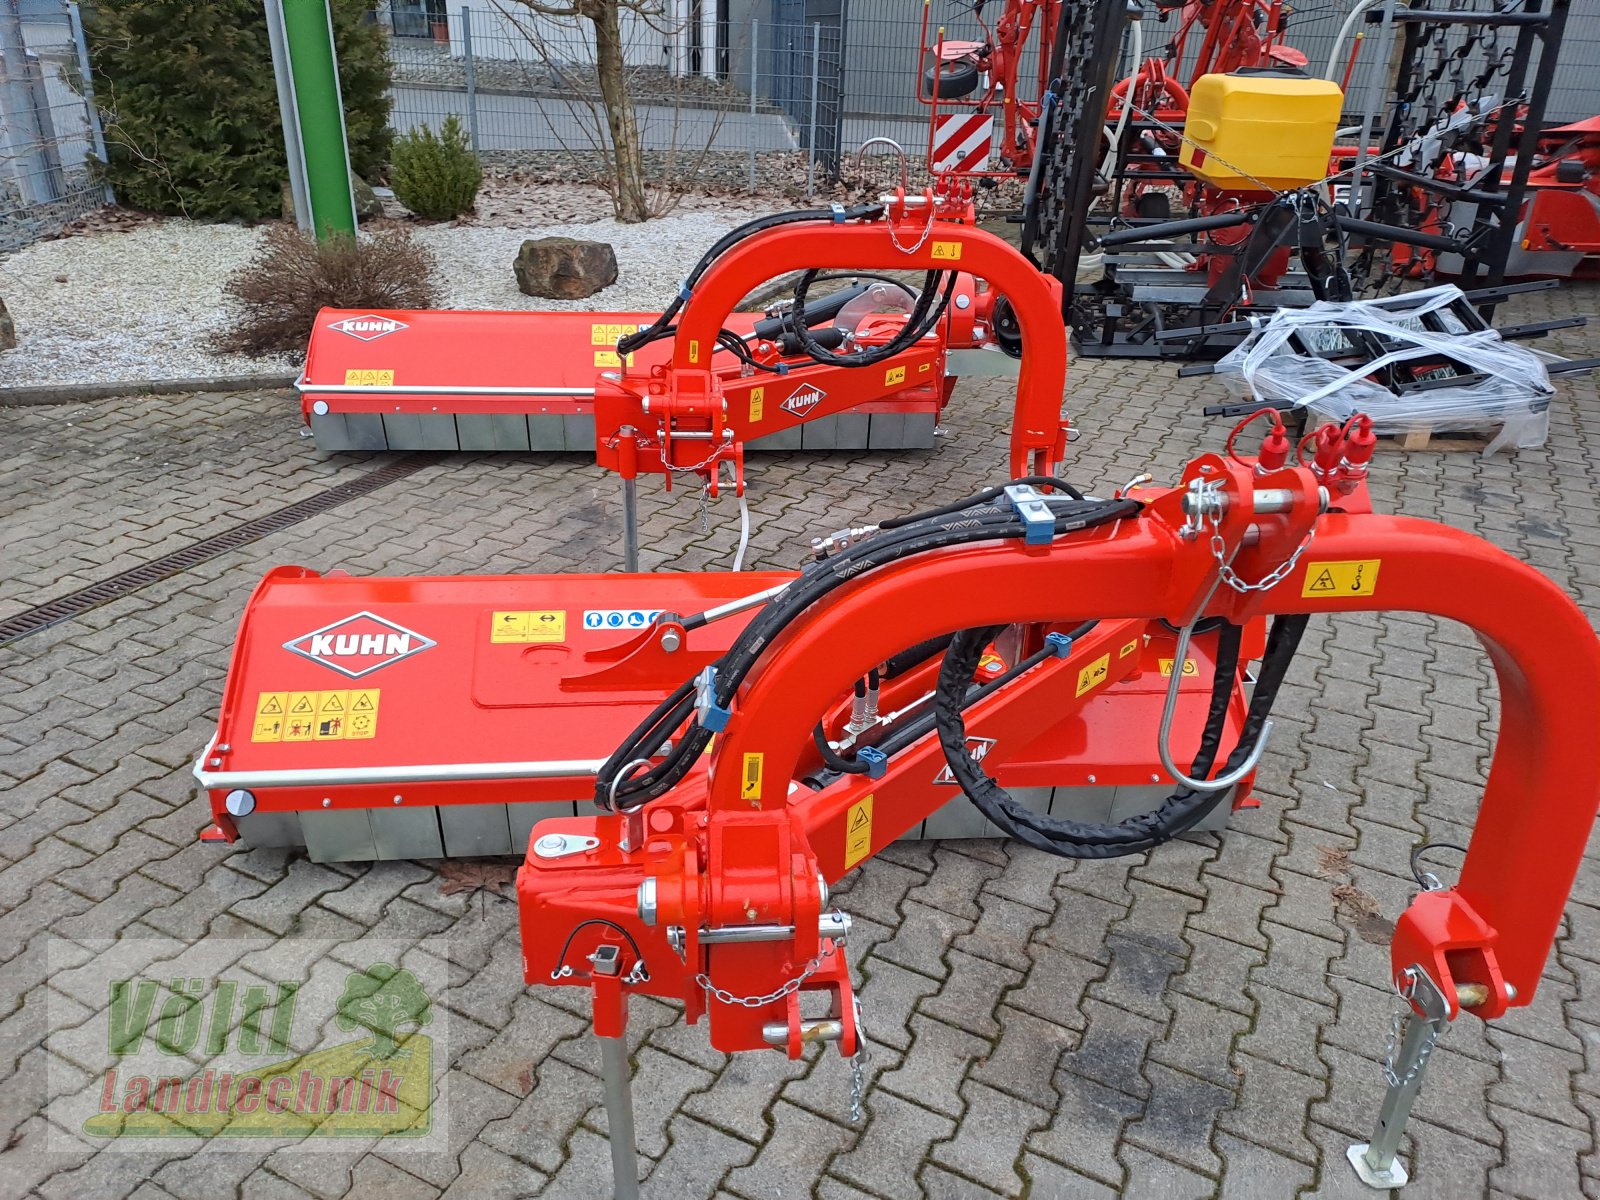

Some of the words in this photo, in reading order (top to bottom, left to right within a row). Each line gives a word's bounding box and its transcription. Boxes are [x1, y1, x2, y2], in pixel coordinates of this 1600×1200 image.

[342, 321, 396, 331] KUHN
[788, 391, 819, 410] KUHN
[310, 634, 410, 656] KUHN
